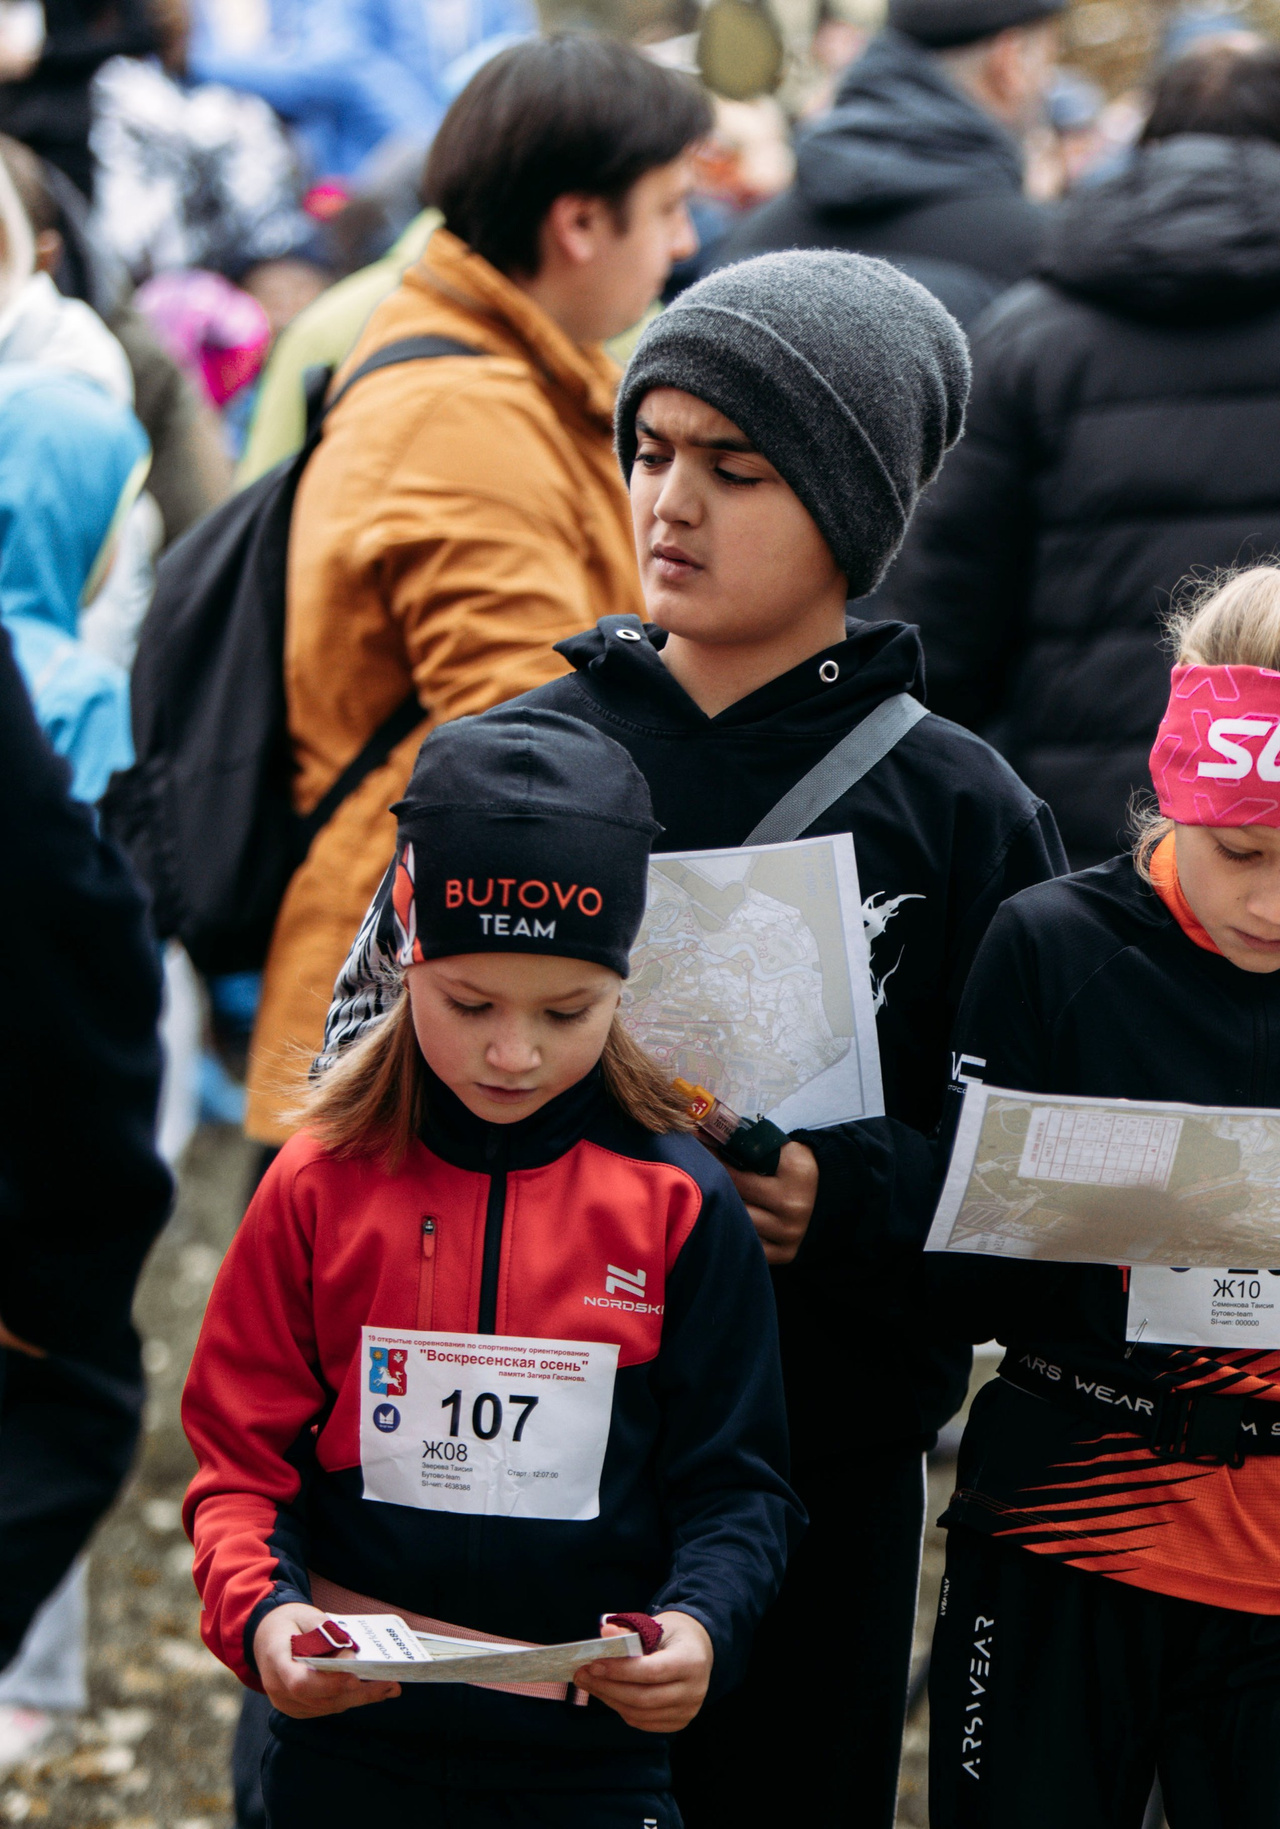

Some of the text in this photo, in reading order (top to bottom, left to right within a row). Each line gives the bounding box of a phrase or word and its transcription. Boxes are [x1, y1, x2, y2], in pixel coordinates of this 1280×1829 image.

[445, 878, 603, 917] BUTOVO
[479, 913, 556, 940] TEAM
[1213, 1279, 1261, 1299] Ж10
[583, 1296, 664, 1315] NORDSKI
[377, 1336, 412, 1345] открытые
[414, 1339, 466, 1348] соревнования
[478, 1344, 527, 1353] спортивному
[529, 1347, 590, 1357] ориентированию
[420, 1348, 589, 1371] "Воскресенская осень"
[527, 1371, 550, 1380] Загира
[441, 1389, 539, 1441] 107
[422, 1440, 468, 1461] Ж08
[507, 1469, 527, 1478] Старт
